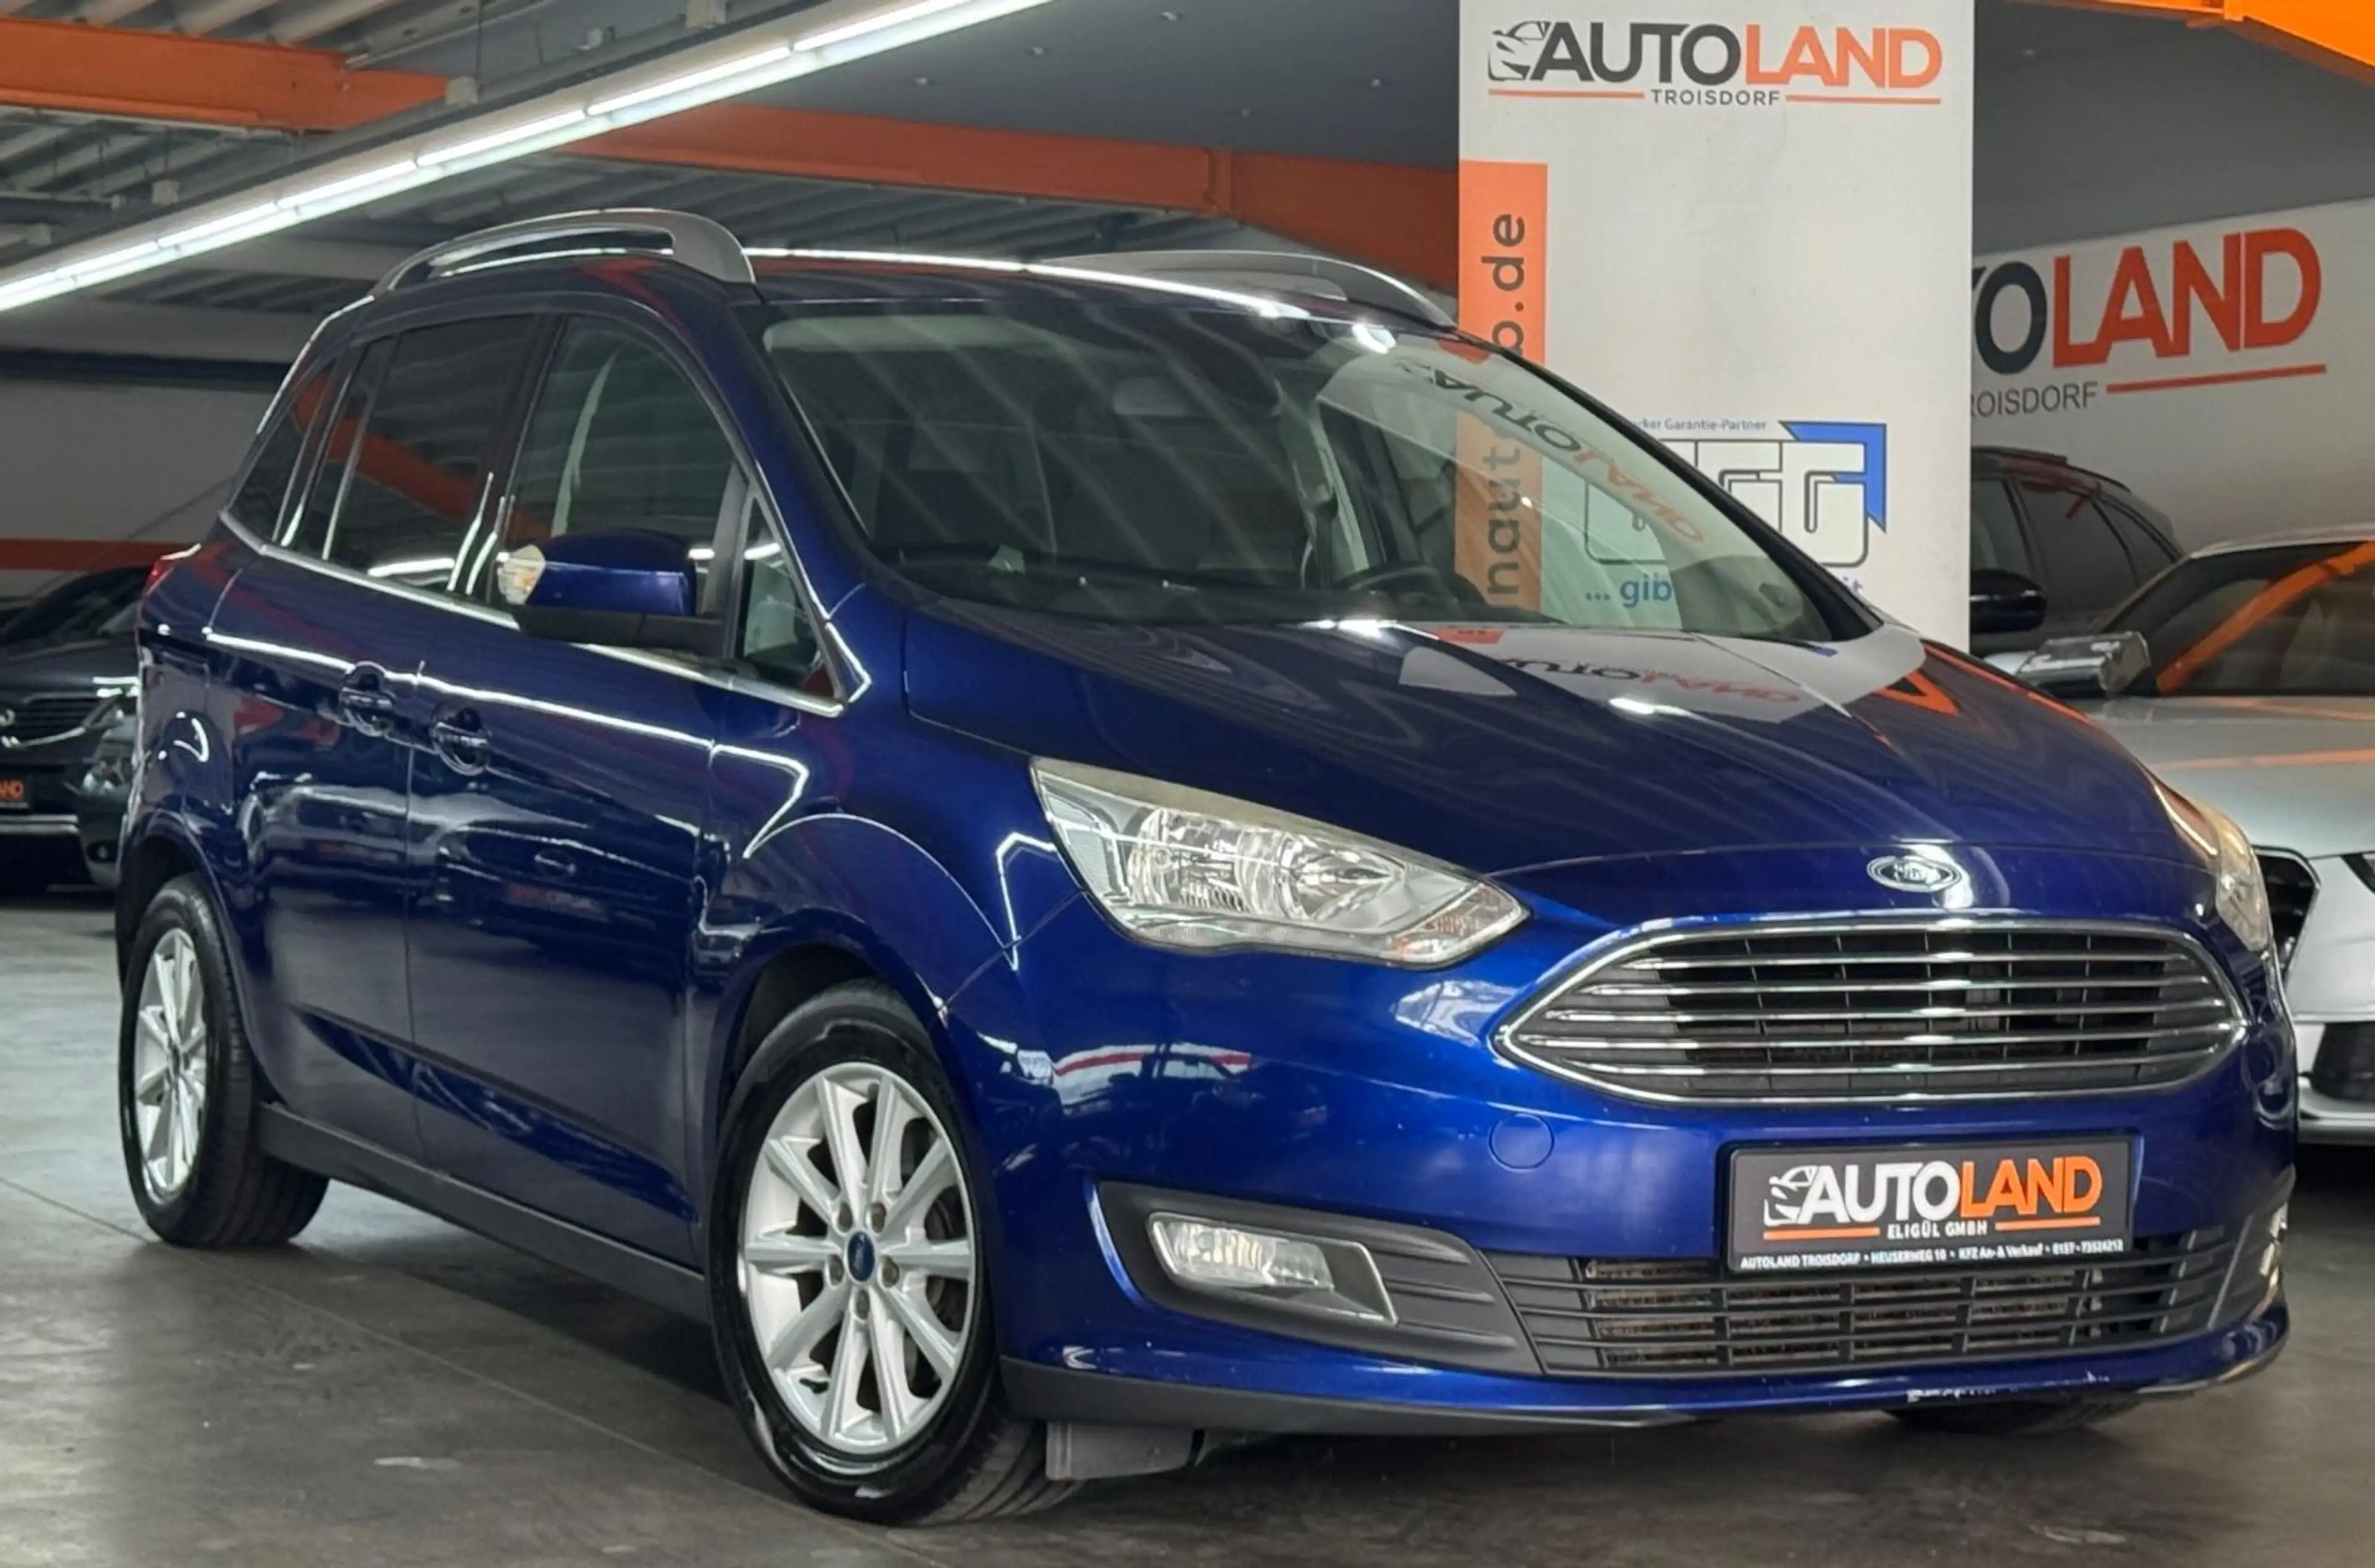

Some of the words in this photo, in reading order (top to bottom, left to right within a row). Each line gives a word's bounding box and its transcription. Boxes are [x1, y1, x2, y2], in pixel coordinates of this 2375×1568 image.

[1529, 22, 1943, 88] AUTOLAND
[1651, 88, 1781, 106] TROISDORF
[1796, 1154, 2103, 1224] AUTOLAND
[1886, 1221, 1940, 1240] ELIGÜL
[1740, 1255, 1800, 1270] AUTOLAND
[1800, 1252, 1861, 1267] TROISDORF
